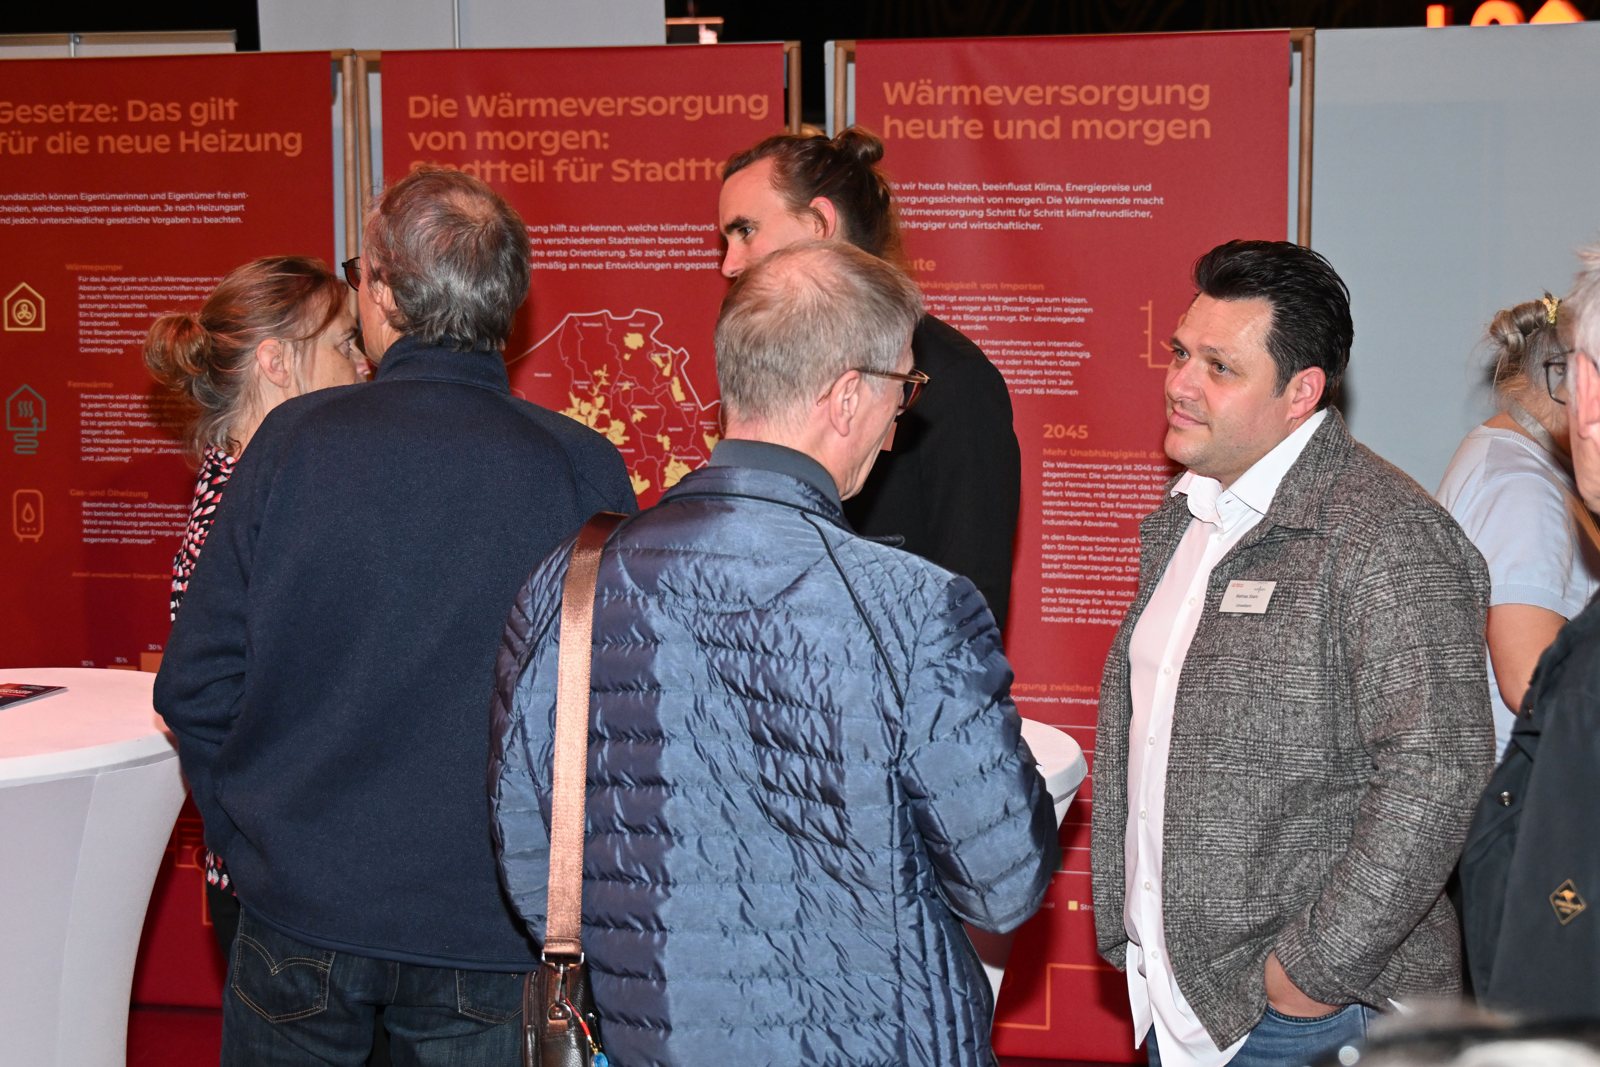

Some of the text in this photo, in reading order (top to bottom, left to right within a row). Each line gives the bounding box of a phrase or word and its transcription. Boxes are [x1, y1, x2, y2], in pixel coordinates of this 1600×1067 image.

[883, 80, 1210, 111] Wärmeversorgung
[127, 100, 182, 122] Das
[189, 97, 239, 127] gilt
[409, 92, 769, 122] Die Wärmeversorgung
[882, 114, 1212, 146] heute und morgen
[46, 131, 90, 154] die
[98, 134, 170, 154] neue
[180, 128, 302, 157] Heizung
[408, 128, 609, 156] von morgen:
[552, 157, 603, 182] für
[901, 182, 1152, 193] wir heute heizen, beeinflusst Klima, Energiepreise und
[79, 193, 148, 202] Eigentümerinnen
[167, 192, 215, 201] Eigentümer
[1005, 198, 1044, 206] morgen.
[1045, 196, 1063, 204] Die
[1064, 196, 1131, 205] Wärmewende
[1132, 197, 1164, 205] macht
[65, 205, 109, 214] Heizsystem
[196, 204, 245, 213] Heizungsart
[985, 209, 1016, 217] Schritt
[1017, 209, 1031, 217] für
[1032, 209, 1064, 217] Schritt
[1065, 209, 1153, 219] klimafreundlicher,
[11, 217, 38, 226] jedoch
[105, 217, 150, 226] gesetzliche
[151, 217, 190, 225] Vorgaben
[968, 221, 1043, 230] wirtschaftlicher.
[580, 224, 625, 233] erkennen,
[569, 249, 627, 258] Orientierung.
[644, 249, 666, 258] zeigt
[604, 262, 671, 271] Entwicklungen
[672, 263, 720, 271] angepasst.
[1042, 424, 1088, 439] 2045
